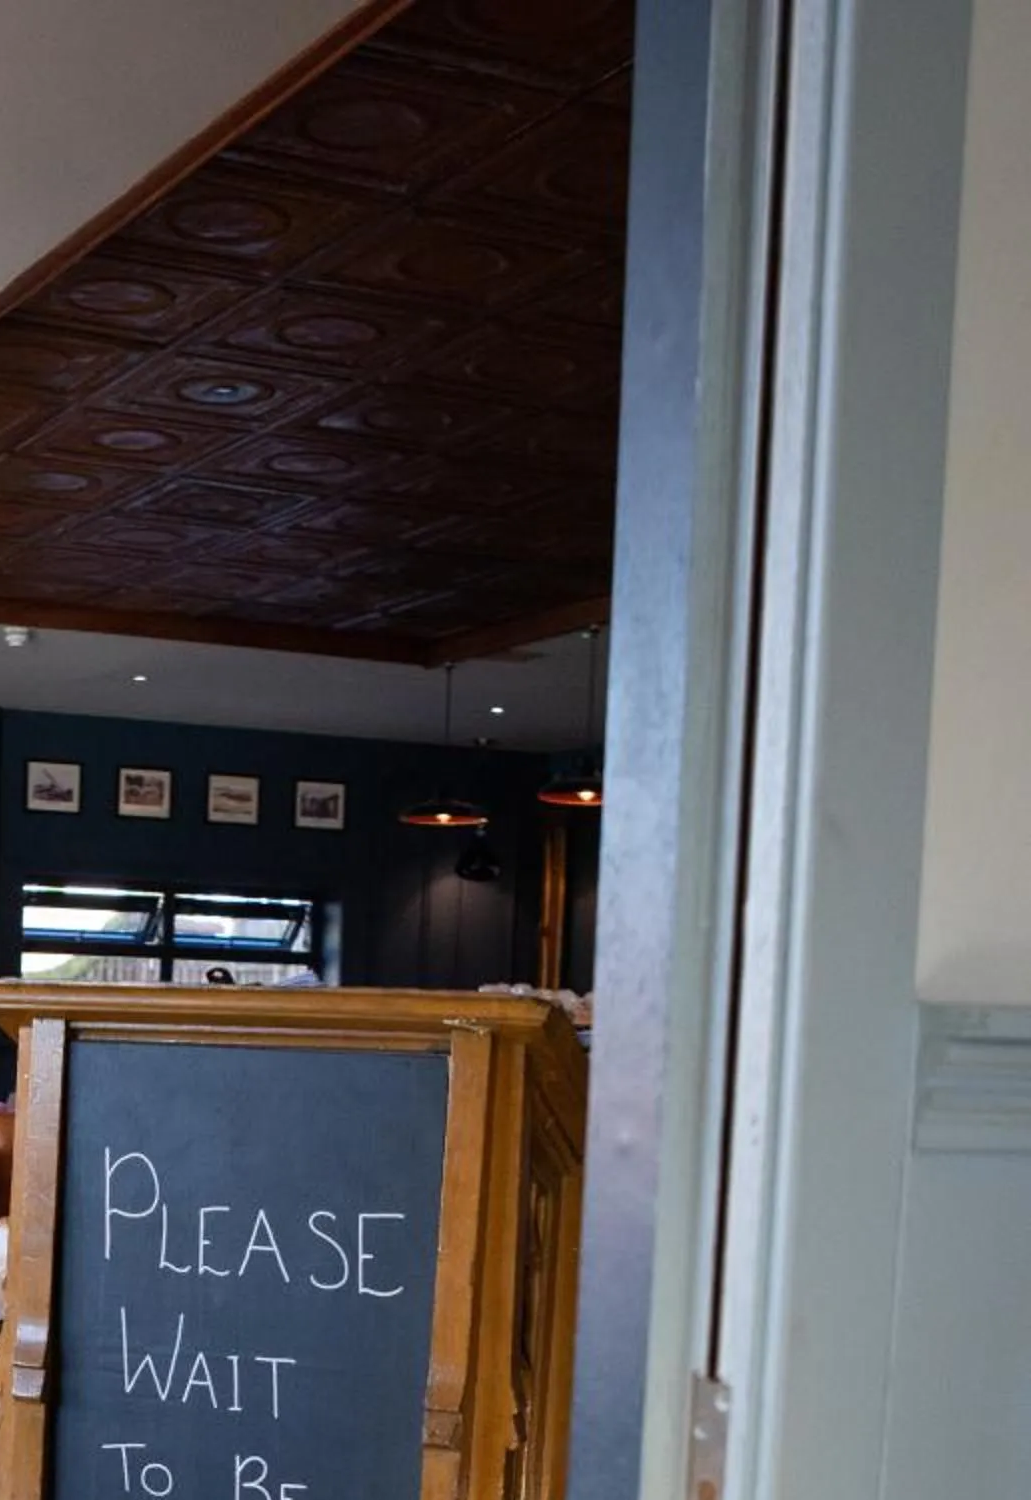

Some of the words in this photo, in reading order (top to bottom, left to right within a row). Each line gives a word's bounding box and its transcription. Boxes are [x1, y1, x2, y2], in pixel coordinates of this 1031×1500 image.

[104, 1146, 406, 1298] PLEASE
[119, 1306, 298, 1420] WAIT
[101, 1442, 174, 1498] TO
